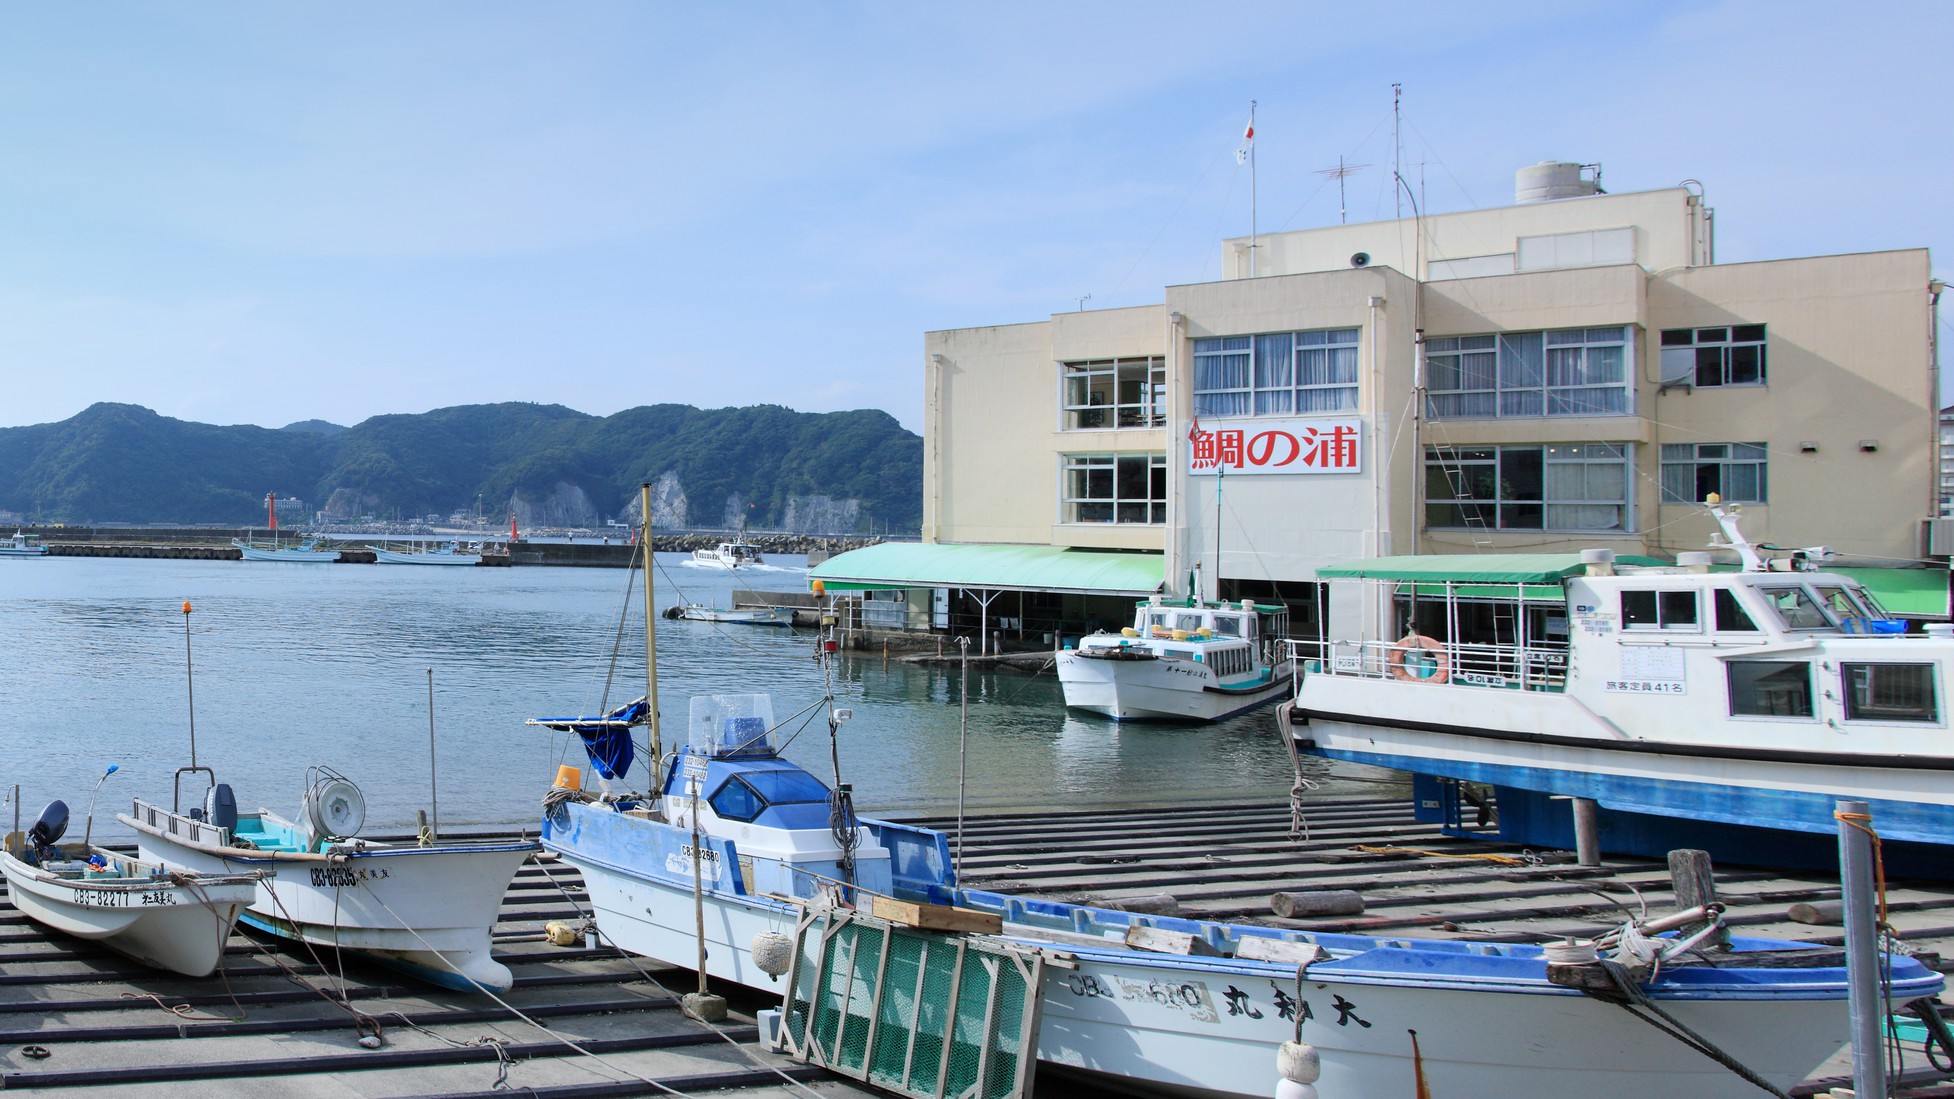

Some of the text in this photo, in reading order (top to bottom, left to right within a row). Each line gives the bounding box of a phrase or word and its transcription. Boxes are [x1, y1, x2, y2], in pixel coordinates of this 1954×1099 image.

[1192, 426, 1358, 469] 鯛の浦
[1606, 681, 1682, 692] 旅客定員41名
[681, 845, 719, 862] CB382680
[74, 888, 129, 907] CB3-82277
